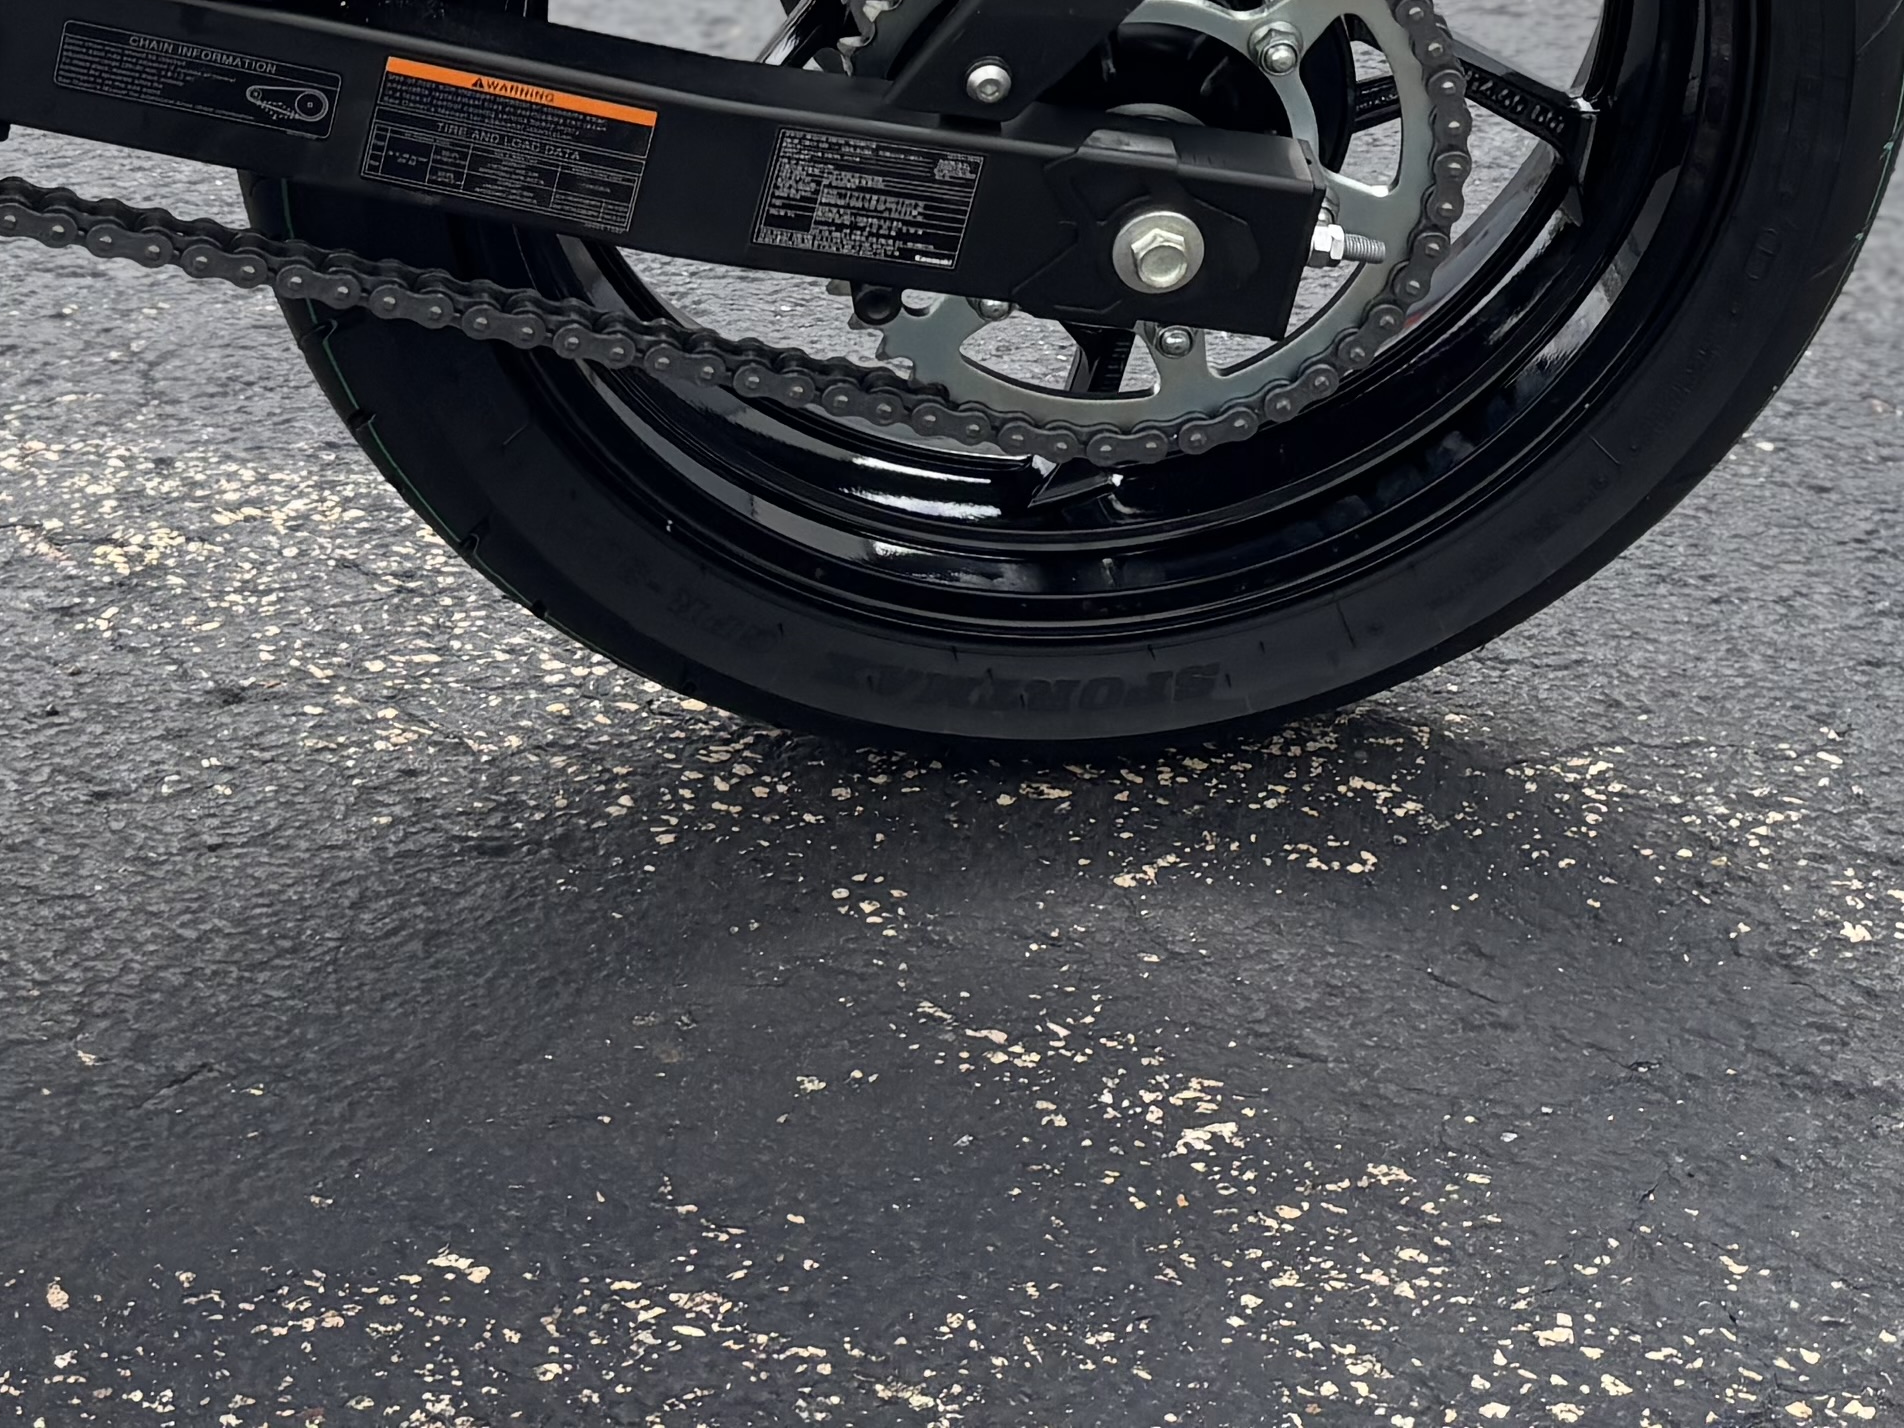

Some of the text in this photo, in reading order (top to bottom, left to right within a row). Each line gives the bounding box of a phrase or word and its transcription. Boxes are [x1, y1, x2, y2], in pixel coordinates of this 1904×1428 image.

[128, 35, 277, 75] CHAIN INFORMATION
[485, 80, 555, 103] WARNING
[437, 122, 581, 161] TIRE AND LOAD DATA
